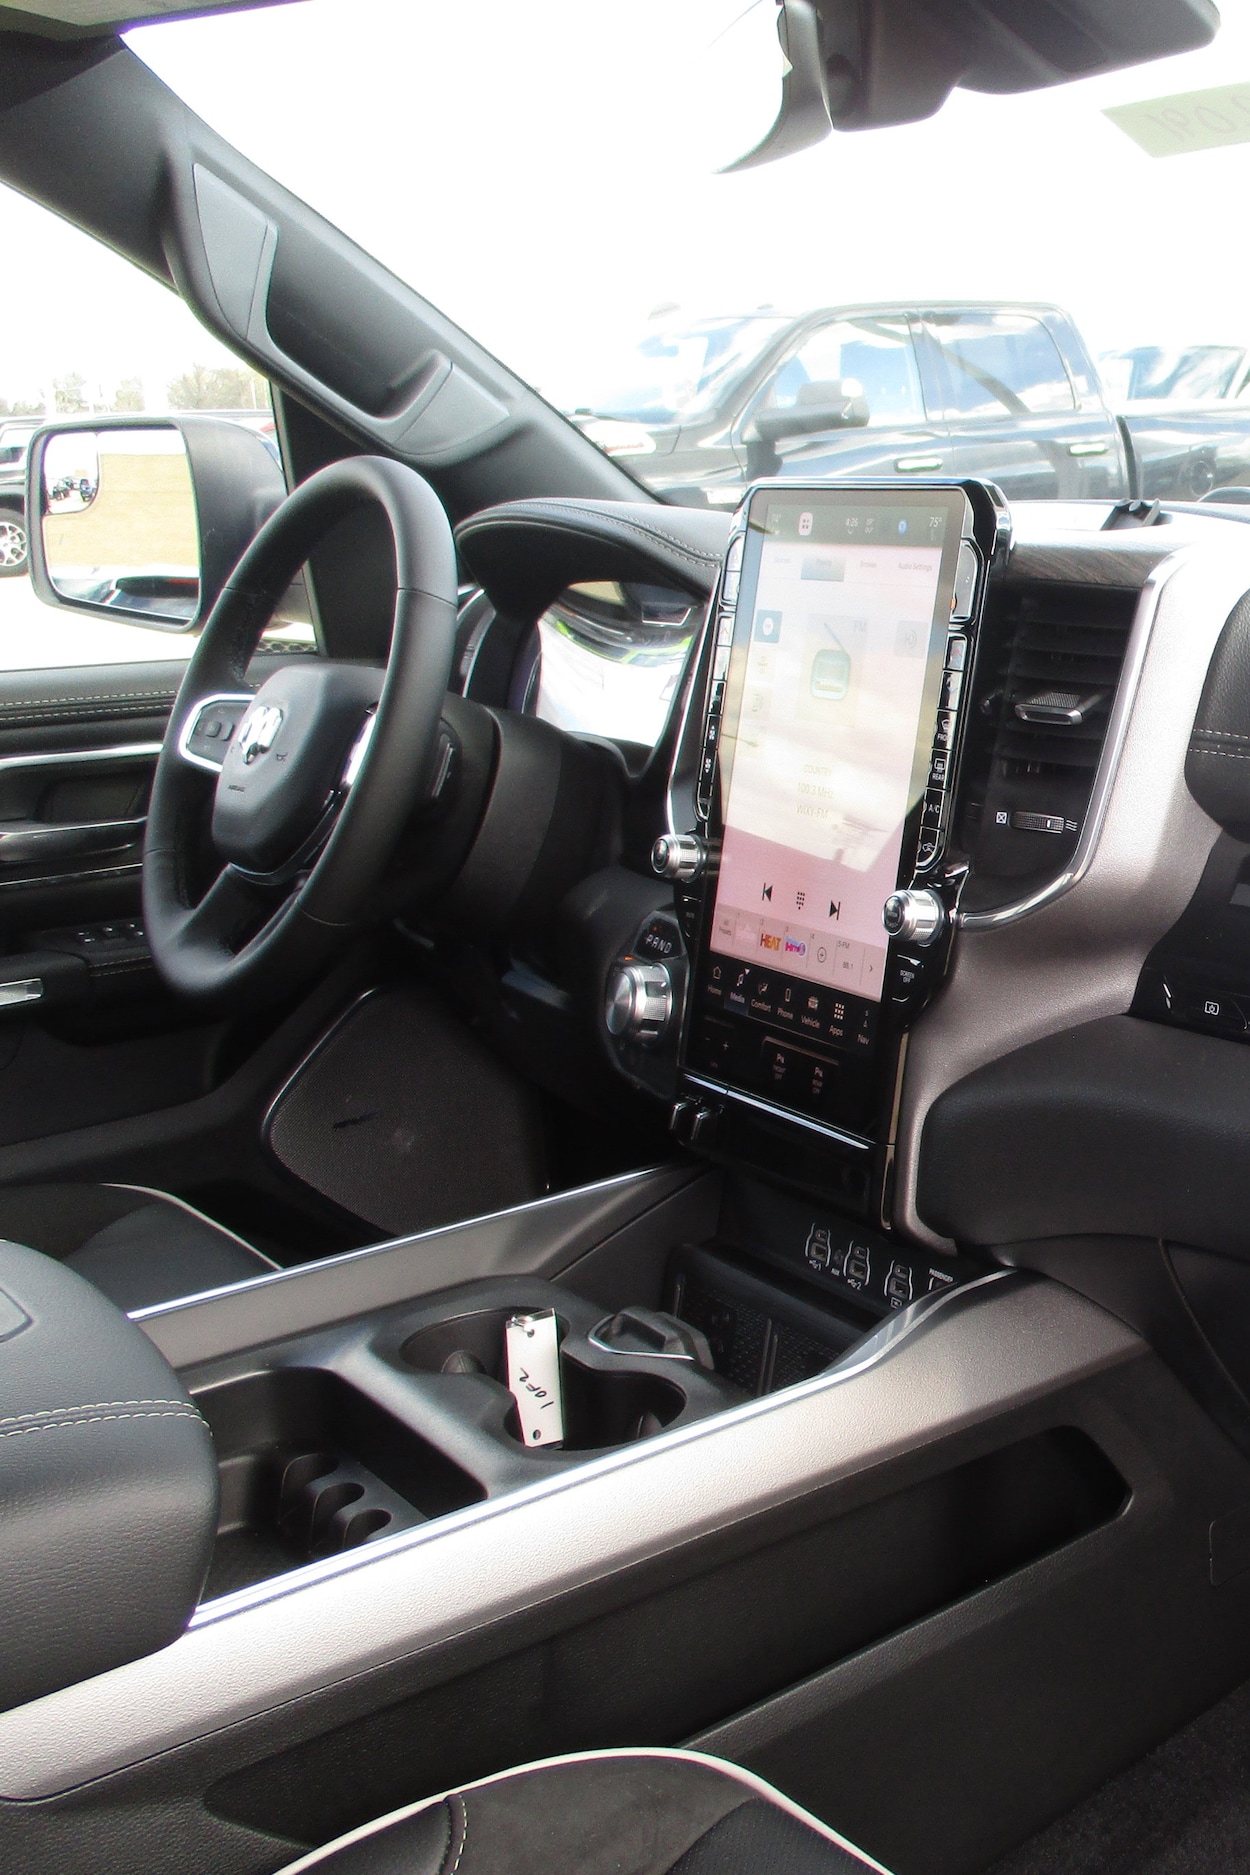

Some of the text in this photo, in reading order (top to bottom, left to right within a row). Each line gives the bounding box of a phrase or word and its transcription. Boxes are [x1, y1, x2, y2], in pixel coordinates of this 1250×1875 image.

[760, 932, 782, 952] HEAT
[707, 984, 722, 996] Home
[729, 991, 746, 1004] Media
[751, 998, 772, 1013] Comfort
[777, 1007, 794, 1020] Phone
[801, 1015, 821, 1030] Vehicle
[829, 1025, 844, 1037] Apps
[857, 1033, 870, 1046] Nav
[519, 1367, 530, 1383] 2
